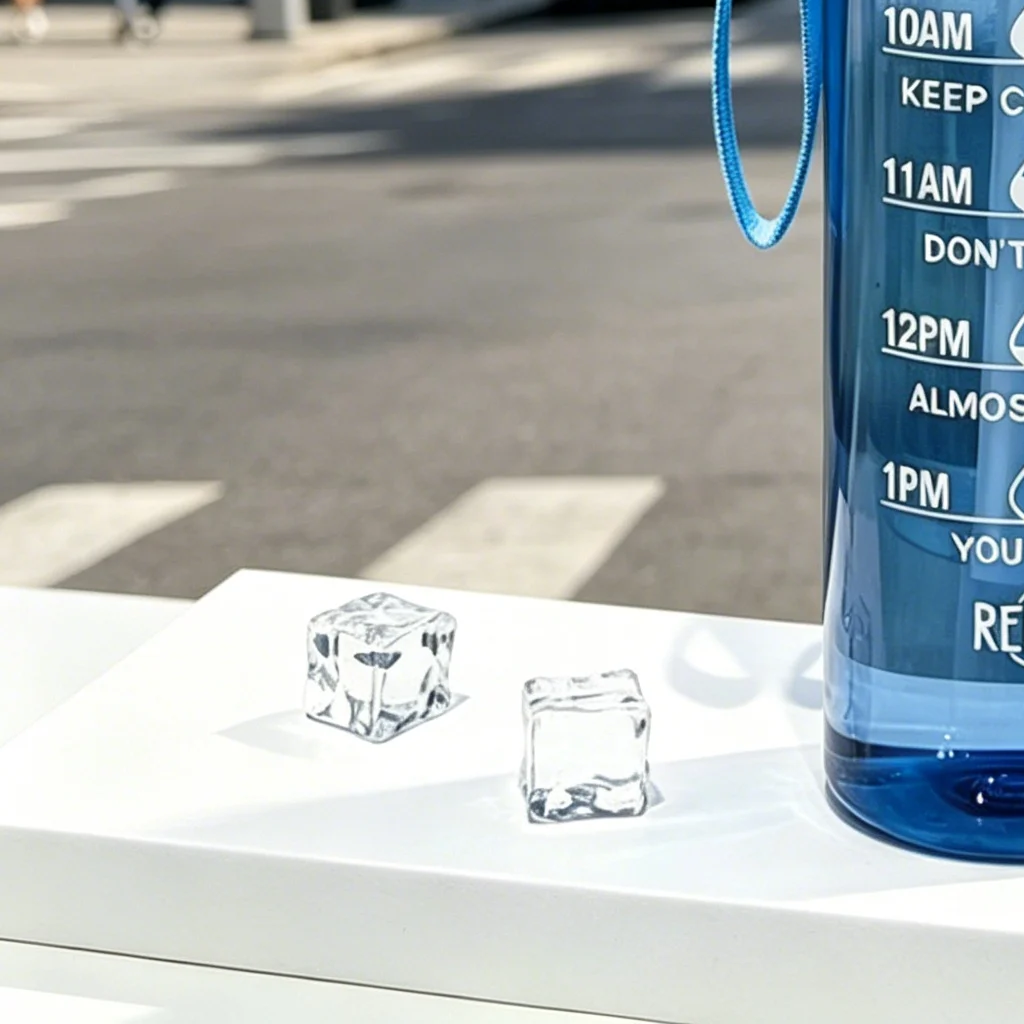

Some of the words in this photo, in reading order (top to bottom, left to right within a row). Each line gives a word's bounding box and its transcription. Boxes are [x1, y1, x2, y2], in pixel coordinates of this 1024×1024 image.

[883, 6, 972, 51] 10AM
[901, 77, 988, 113] KEEP
[882, 158, 972, 205] 11AM
[882, 308, 970, 358] 12PM
[882, 461, 949, 510] 1PM
[951, 532, 1023, 565] YOU
